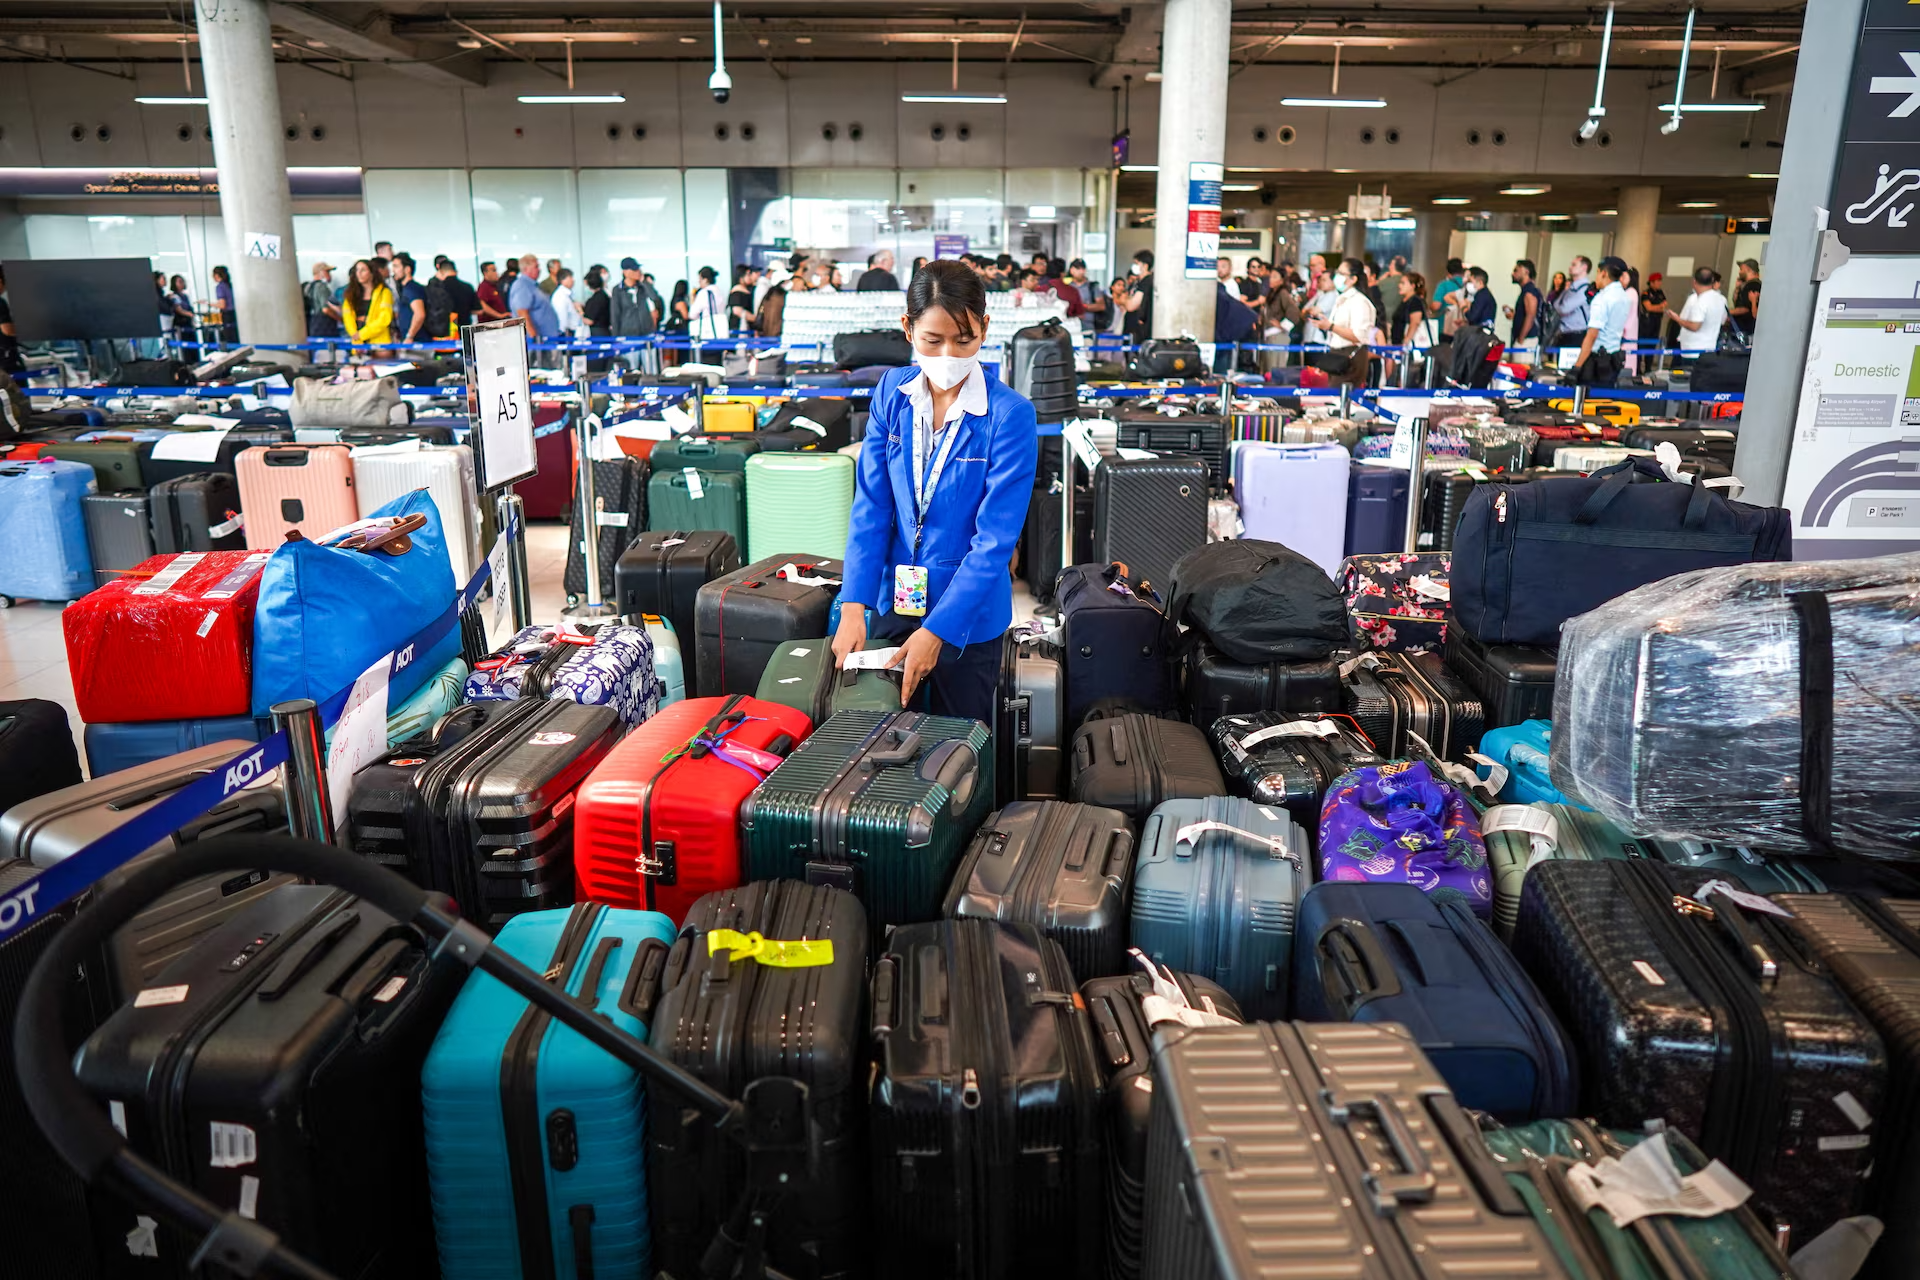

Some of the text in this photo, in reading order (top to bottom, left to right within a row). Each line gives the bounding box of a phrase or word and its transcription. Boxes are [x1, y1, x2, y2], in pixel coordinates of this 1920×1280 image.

[249, 240, 277, 258] A8
[1833, 363, 1901, 378] Domestic
[48, 388, 64, 396] AOT
[117, 388, 133, 396] AOT
[185, 388, 202, 396] AOT
[711, 388, 729, 396] AOT
[781, 388, 800, 396] AOT
[851, 388, 870, 396] AOT
[1080, 389, 1097, 397] AOT
[1293, 388, 1311, 396] AOT
[1363, 388, 1381, 396] AOT
[1434, 388, 1451, 396] AOT
[1504, 389, 1521, 398] AOT
[1645, 391, 1662, 399] AOT
[1713, 393, 1731, 401] AOT
[498, 391, 518, 424] A5
[395, 643, 414, 673] AOT
[223, 749, 265, 795] AOT
